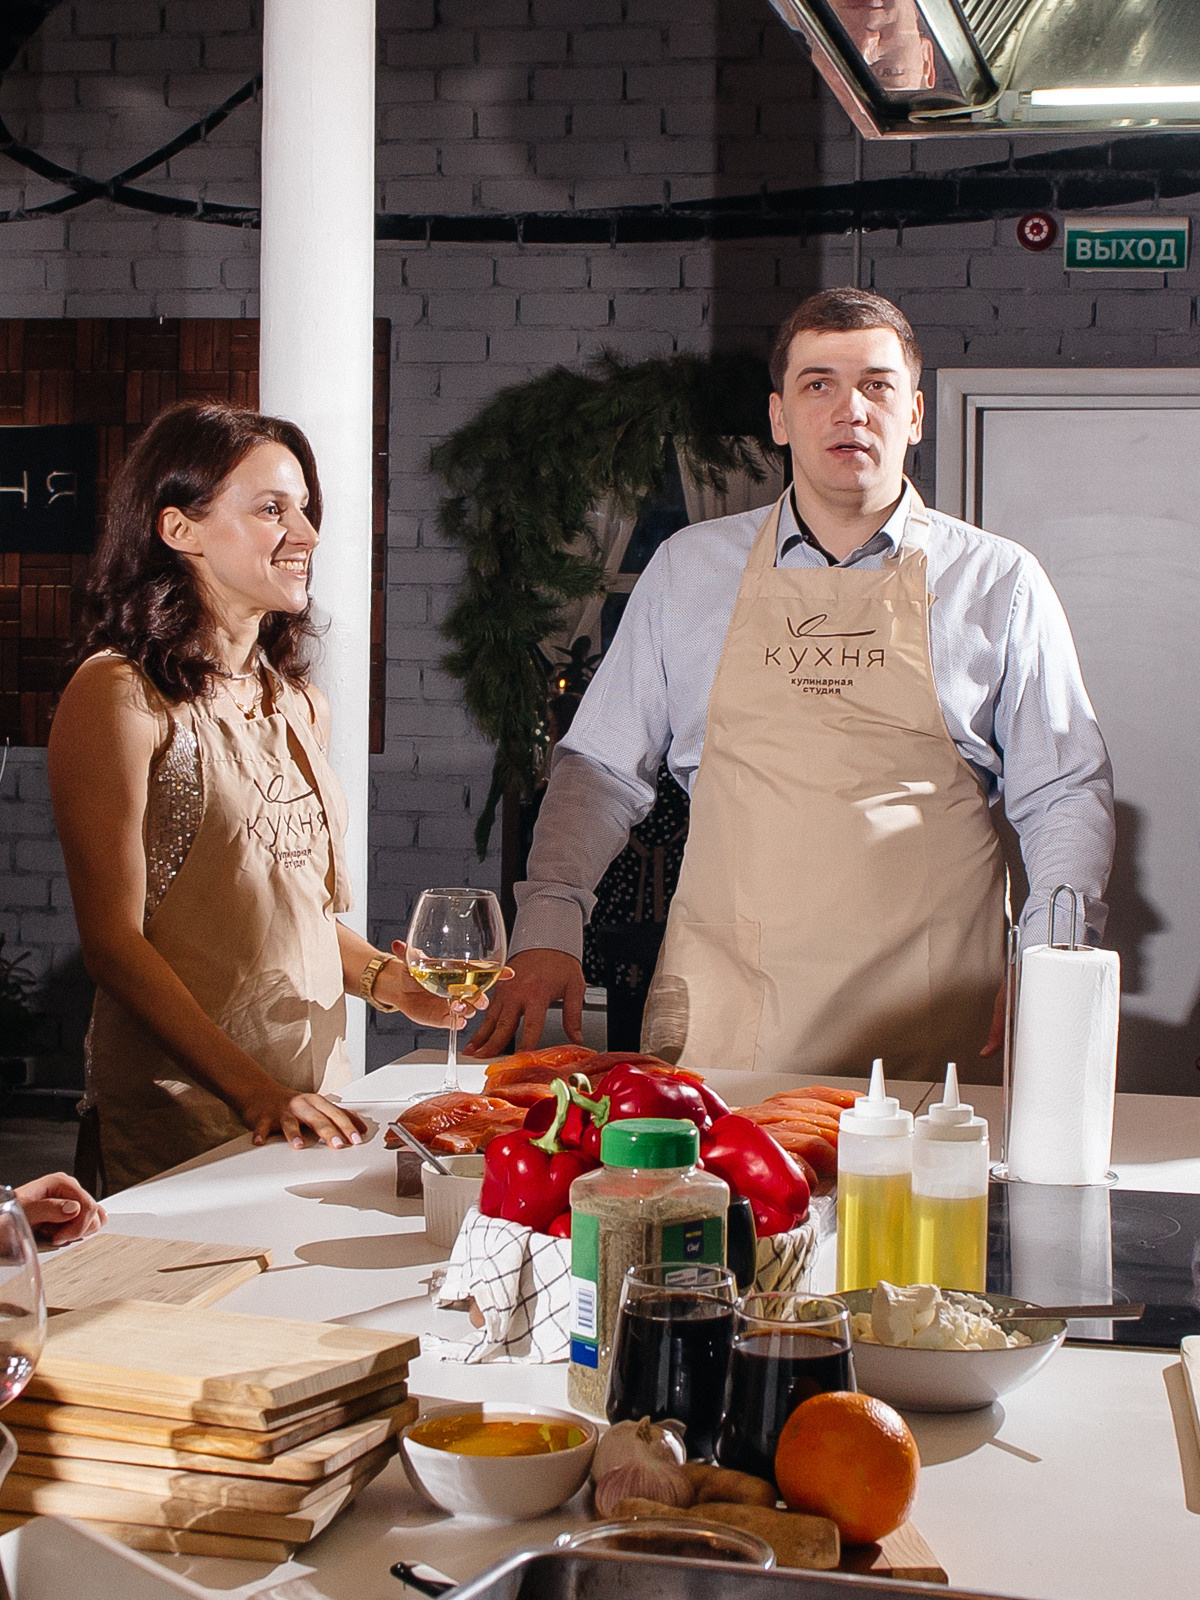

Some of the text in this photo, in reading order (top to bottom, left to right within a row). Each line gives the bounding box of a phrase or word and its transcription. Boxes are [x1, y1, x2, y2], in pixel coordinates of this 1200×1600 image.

[1076, 238, 1177, 264] ВЫХОД
[791, 678, 853, 687] кулинарная
[803, 687, 841, 695] студия
